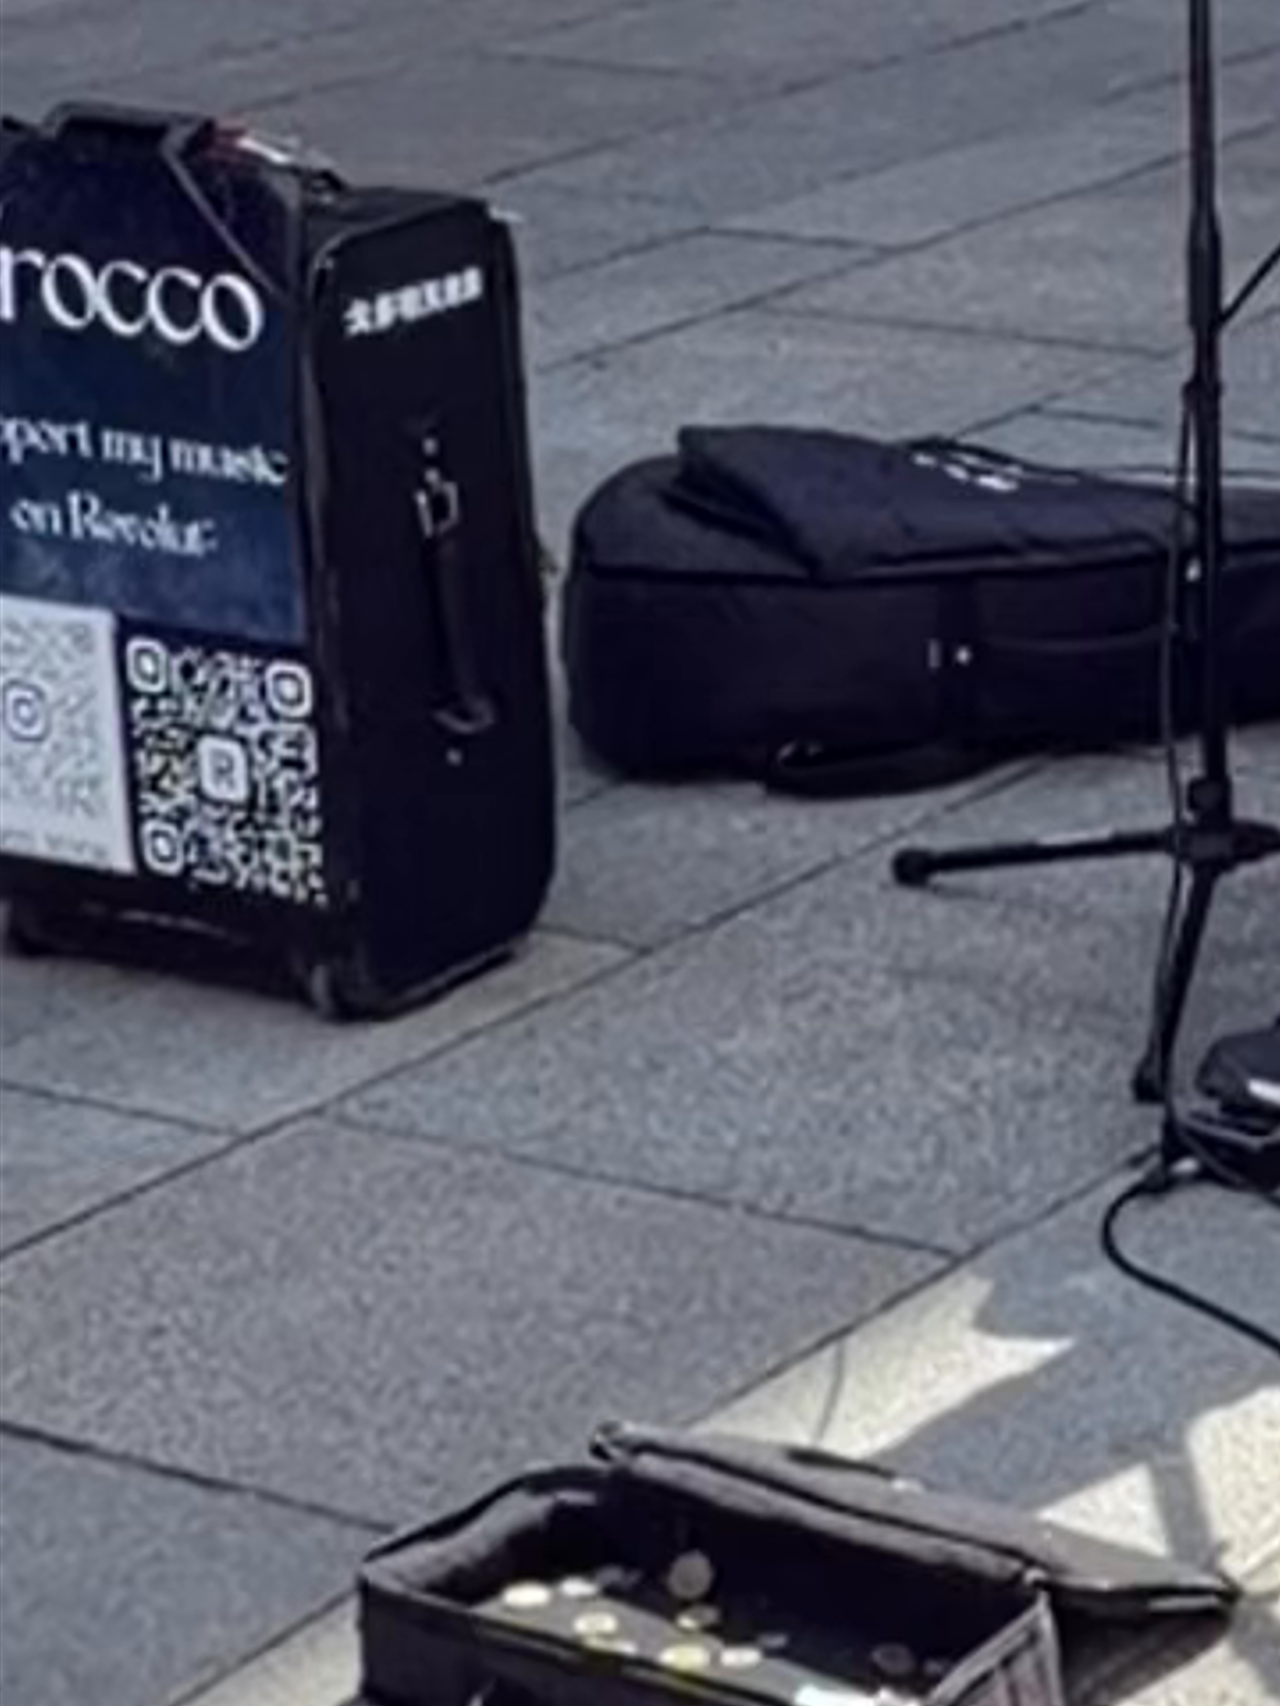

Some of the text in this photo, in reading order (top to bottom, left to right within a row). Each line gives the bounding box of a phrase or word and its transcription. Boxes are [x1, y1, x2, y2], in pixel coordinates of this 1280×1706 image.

[102, 429, 163, 482] my
[168, 438, 289, 485] music
[8, 498, 62, 536] on
